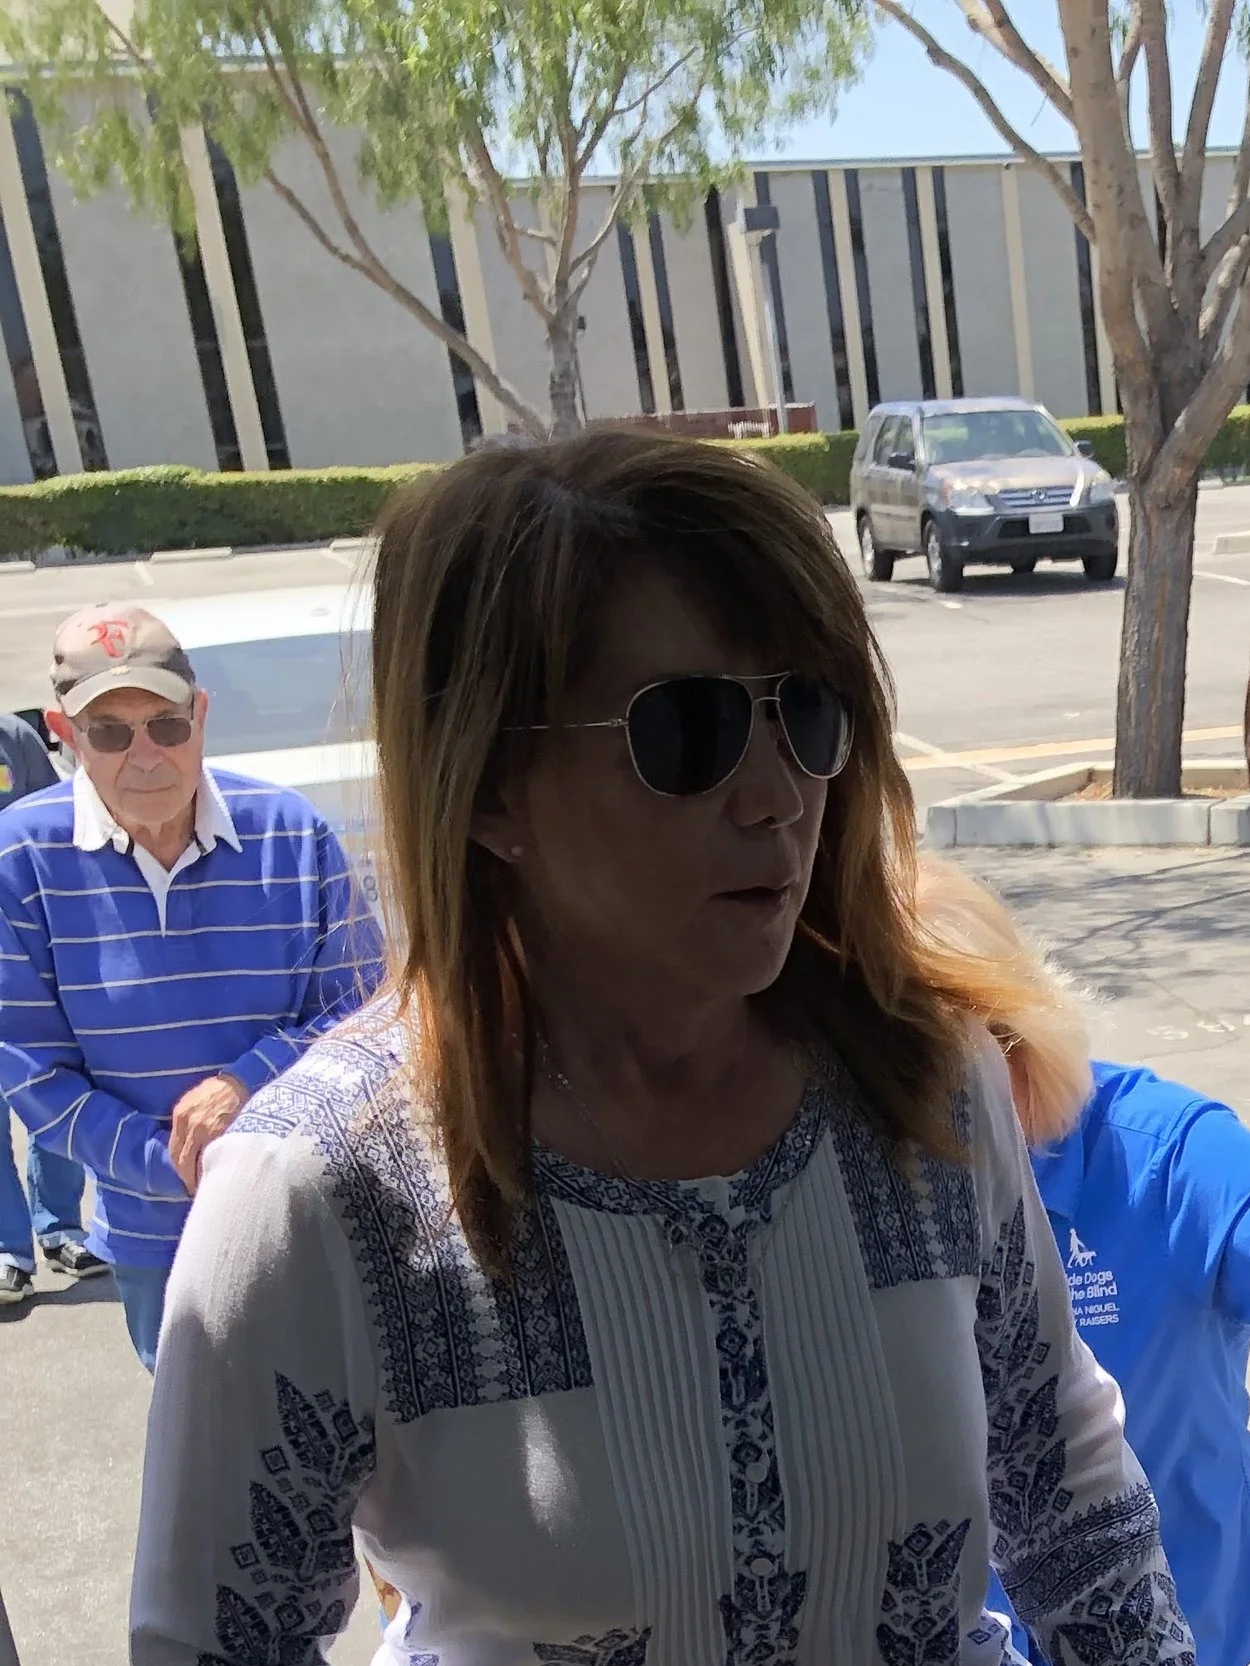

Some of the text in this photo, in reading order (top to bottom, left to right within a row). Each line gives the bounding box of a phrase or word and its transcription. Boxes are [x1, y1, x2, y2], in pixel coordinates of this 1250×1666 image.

[1084, 1270, 1114, 1285] Dogs
[1071, 1281, 1118, 1300] he Blind
[1085, 1302, 1120, 1315] NIGUEL
[1080, 1314, 1120, 1327] RAISERS
